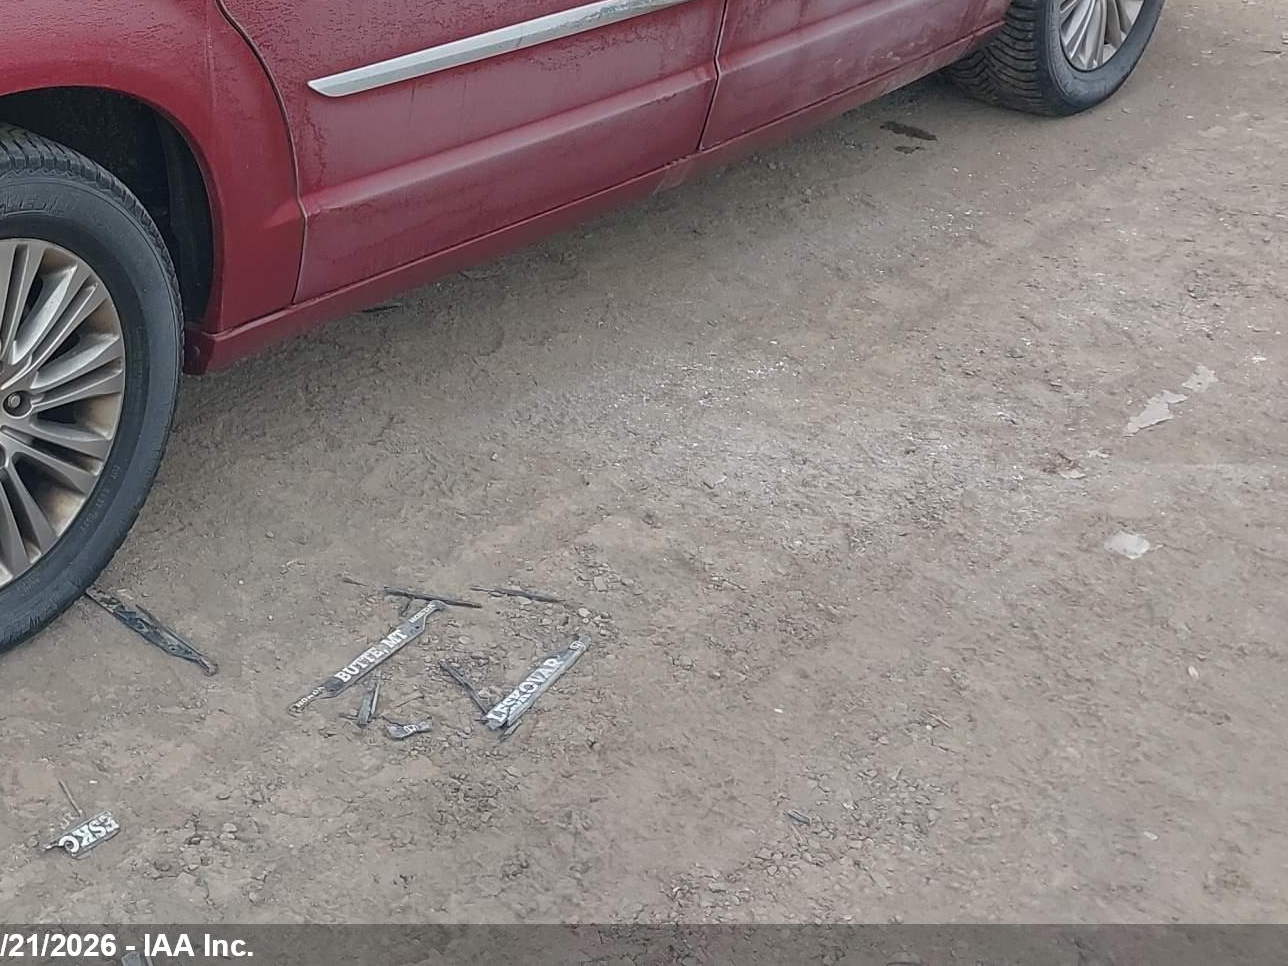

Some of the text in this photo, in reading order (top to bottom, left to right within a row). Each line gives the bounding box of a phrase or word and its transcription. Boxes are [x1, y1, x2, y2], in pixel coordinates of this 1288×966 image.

[334, 646, 389, 683] BUTTE,
[380, 629, 408, 648] MT
[486, 657, 565, 723] LESKOVAR
